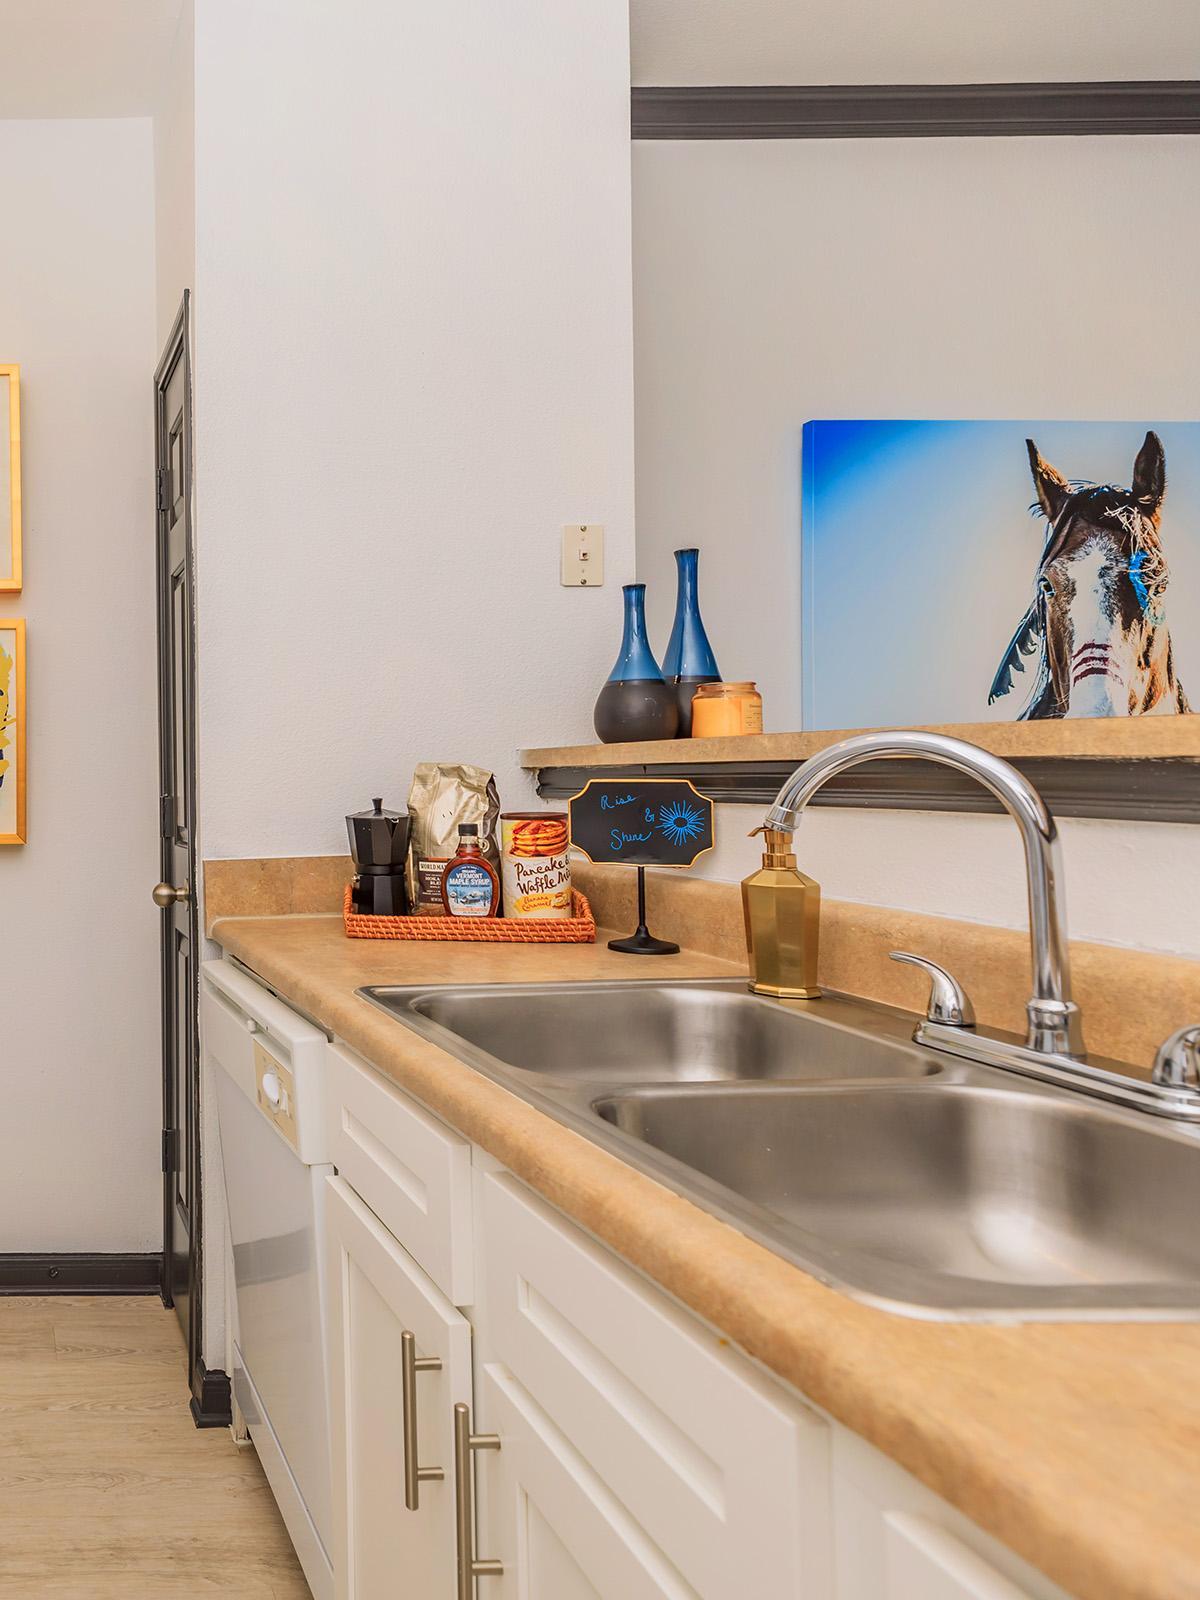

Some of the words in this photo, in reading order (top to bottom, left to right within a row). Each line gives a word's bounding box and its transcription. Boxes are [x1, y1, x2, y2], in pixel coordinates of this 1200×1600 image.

[601, 795, 639, 810] Rise
[644, 808, 655, 822] &
[610, 829, 652, 850] Shine
[514, 857, 565, 881] Pancake
[517, 874, 557, 895] Waffle
